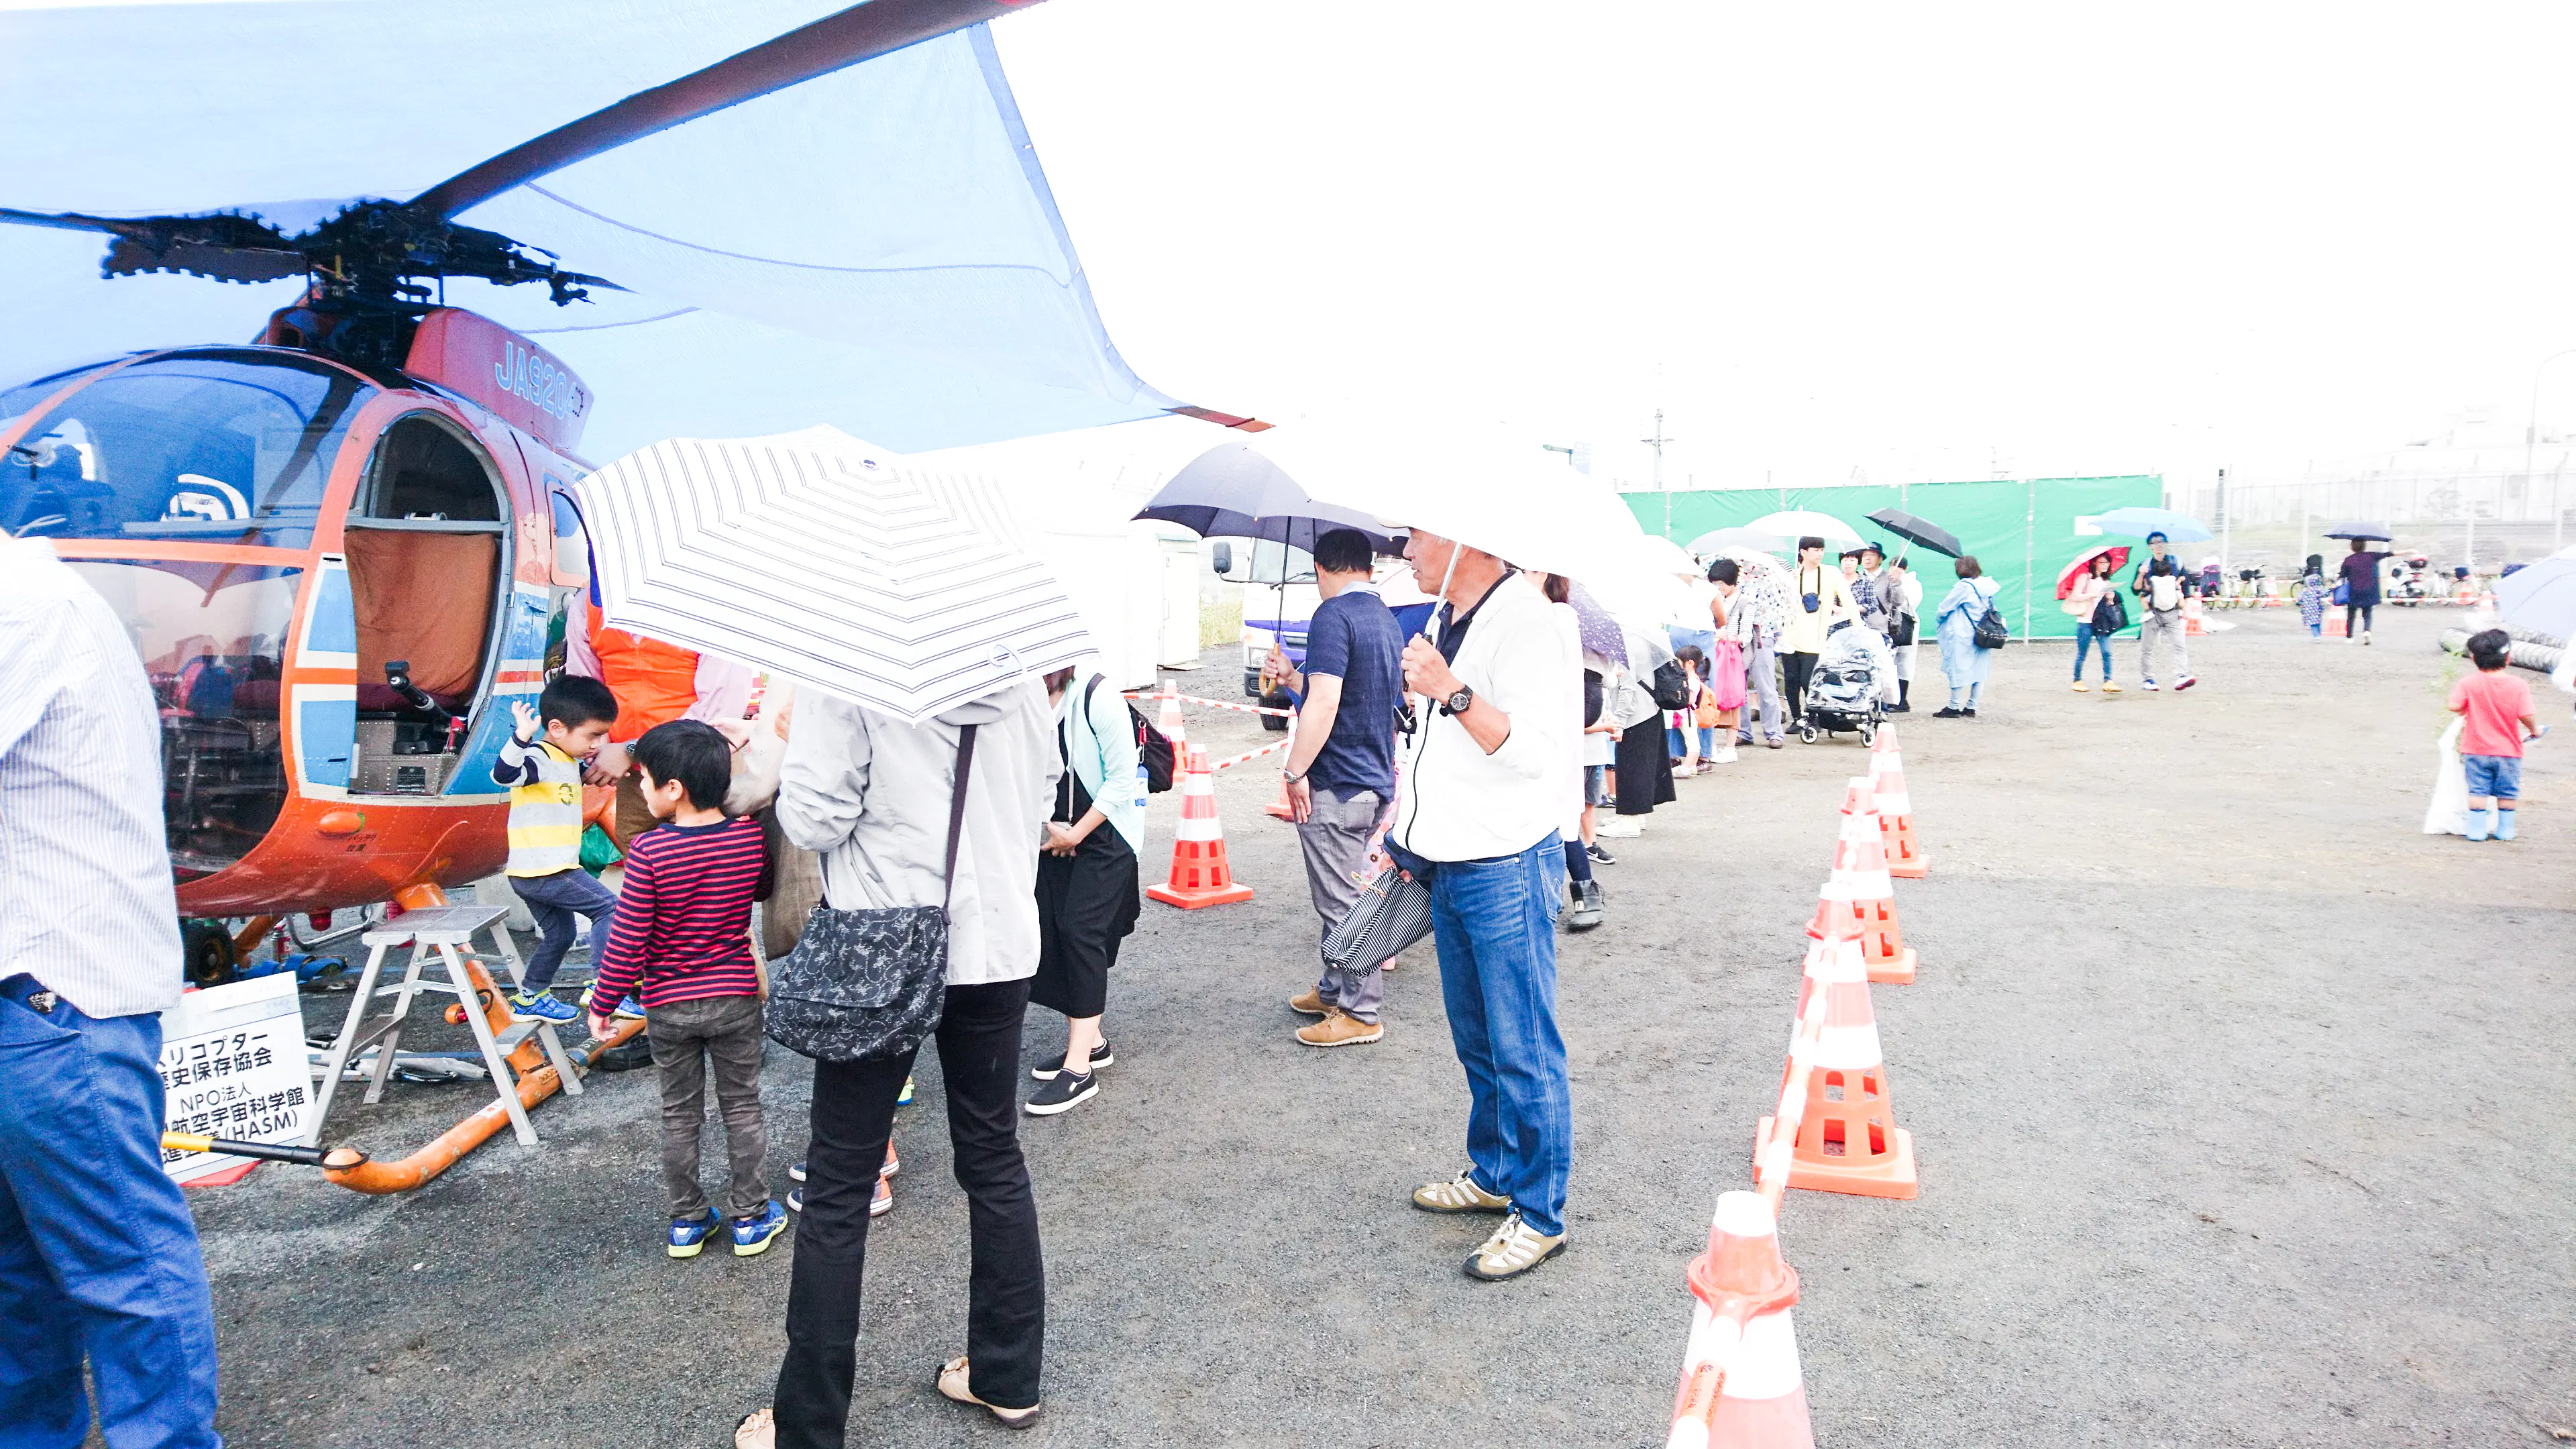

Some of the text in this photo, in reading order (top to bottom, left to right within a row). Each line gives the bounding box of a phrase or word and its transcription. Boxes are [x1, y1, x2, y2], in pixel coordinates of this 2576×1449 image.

[164, 1087, 305, 1134] 航空宇宙科学館
[180, 1081, 252, 1114] NPO法人
